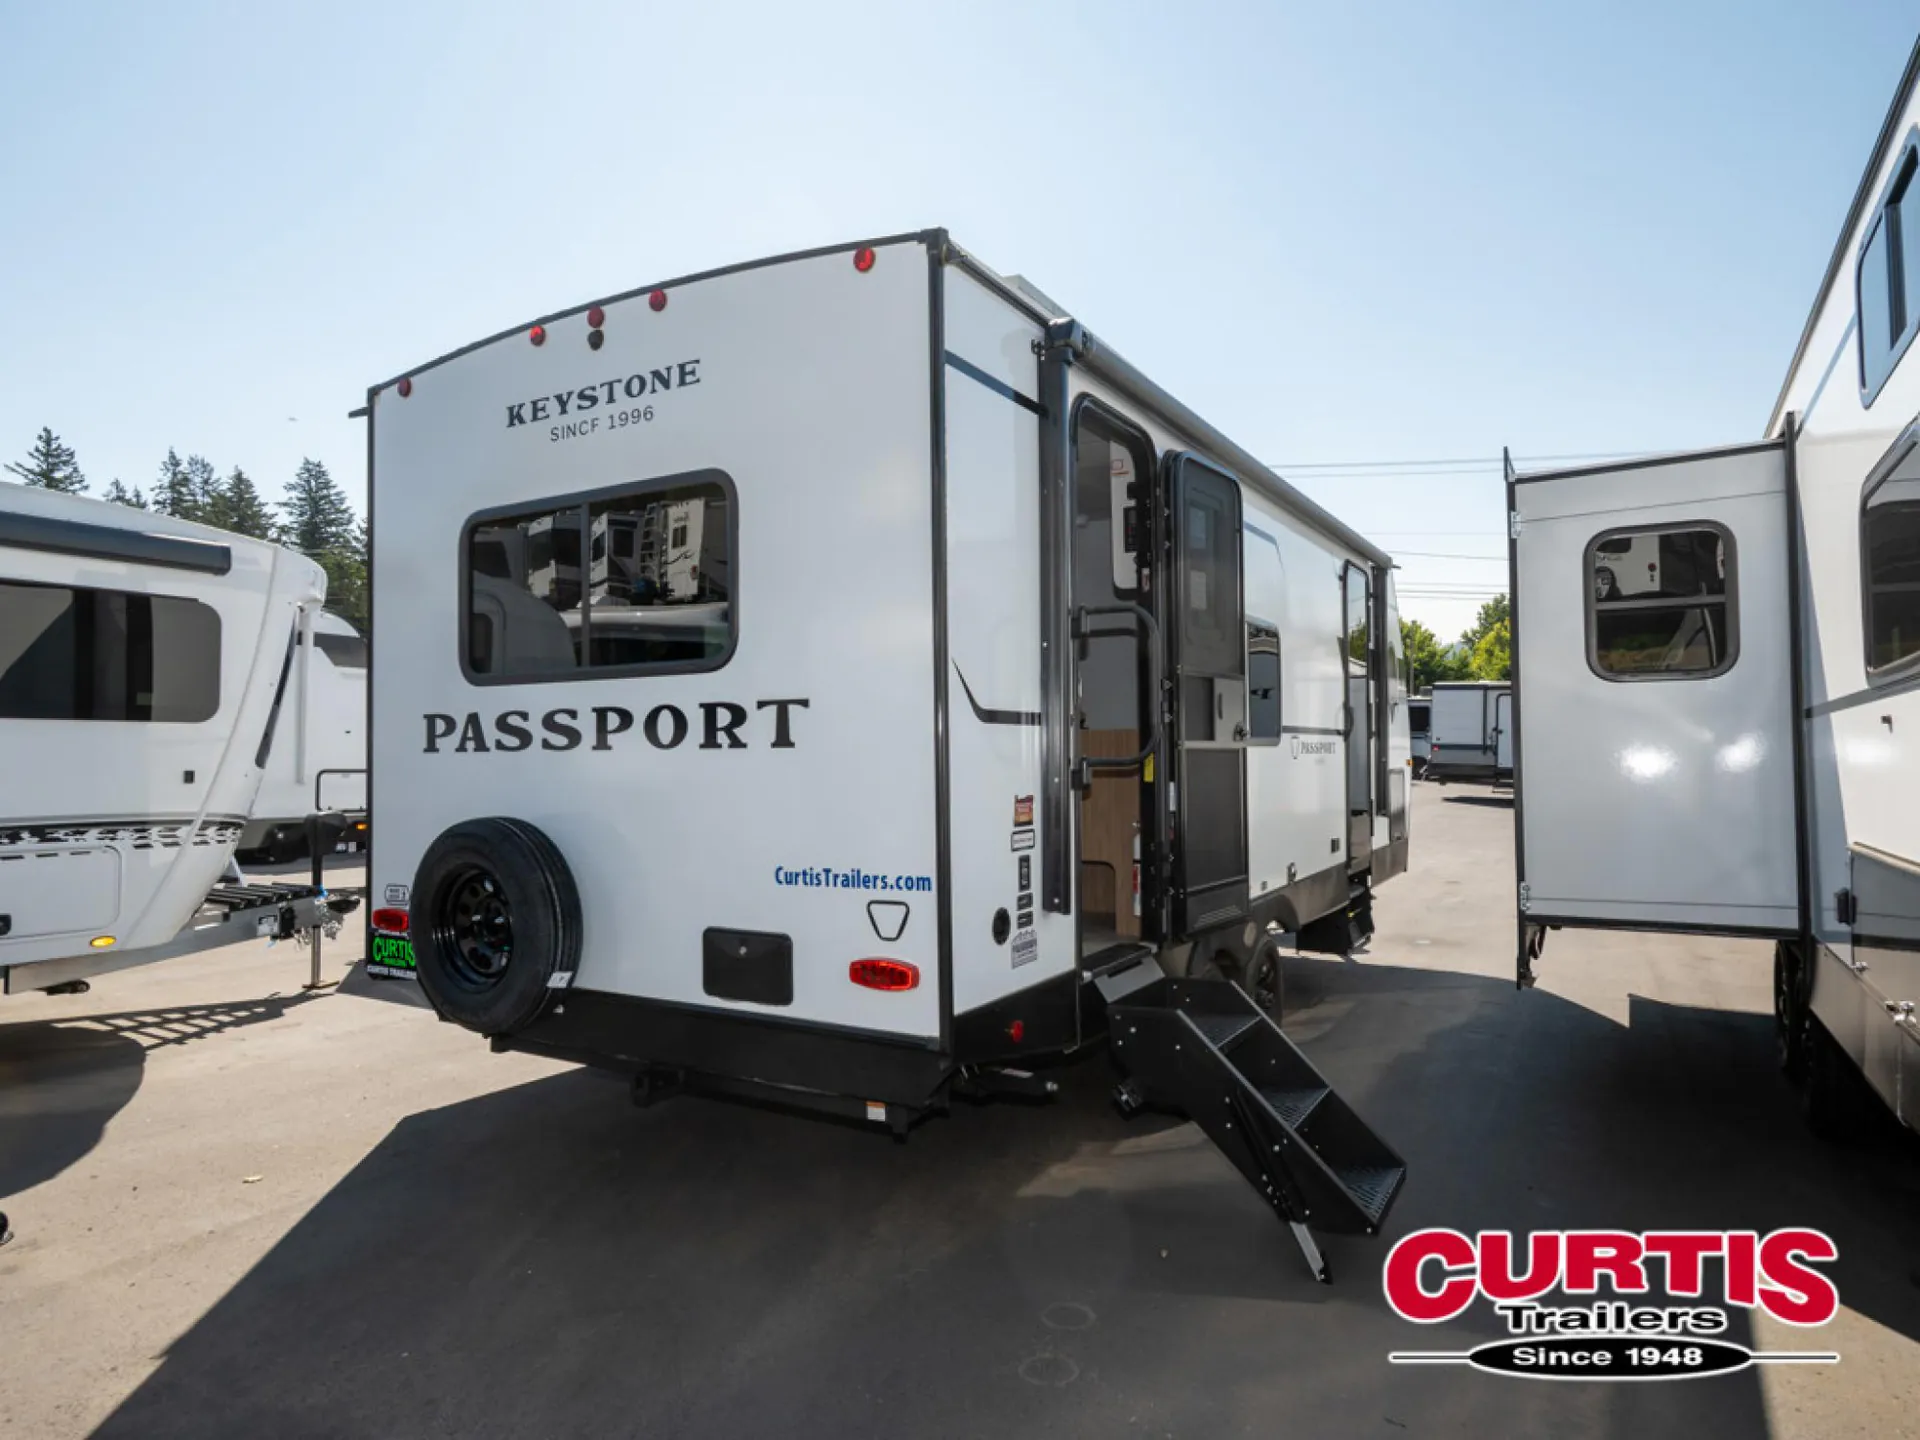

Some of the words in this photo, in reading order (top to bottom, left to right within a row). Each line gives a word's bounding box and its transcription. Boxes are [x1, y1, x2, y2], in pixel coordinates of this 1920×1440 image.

[505, 358, 701, 429] KEYSTONE
[608, 404, 655, 430] 1996
[422, 698, 810, 753] PASSPORT
[1300, 741, 1336, 755] PASSPORT
[774, 865, 932, 892] CurtisTrailers.com
[372, 936, 416, 968] CURTIS
